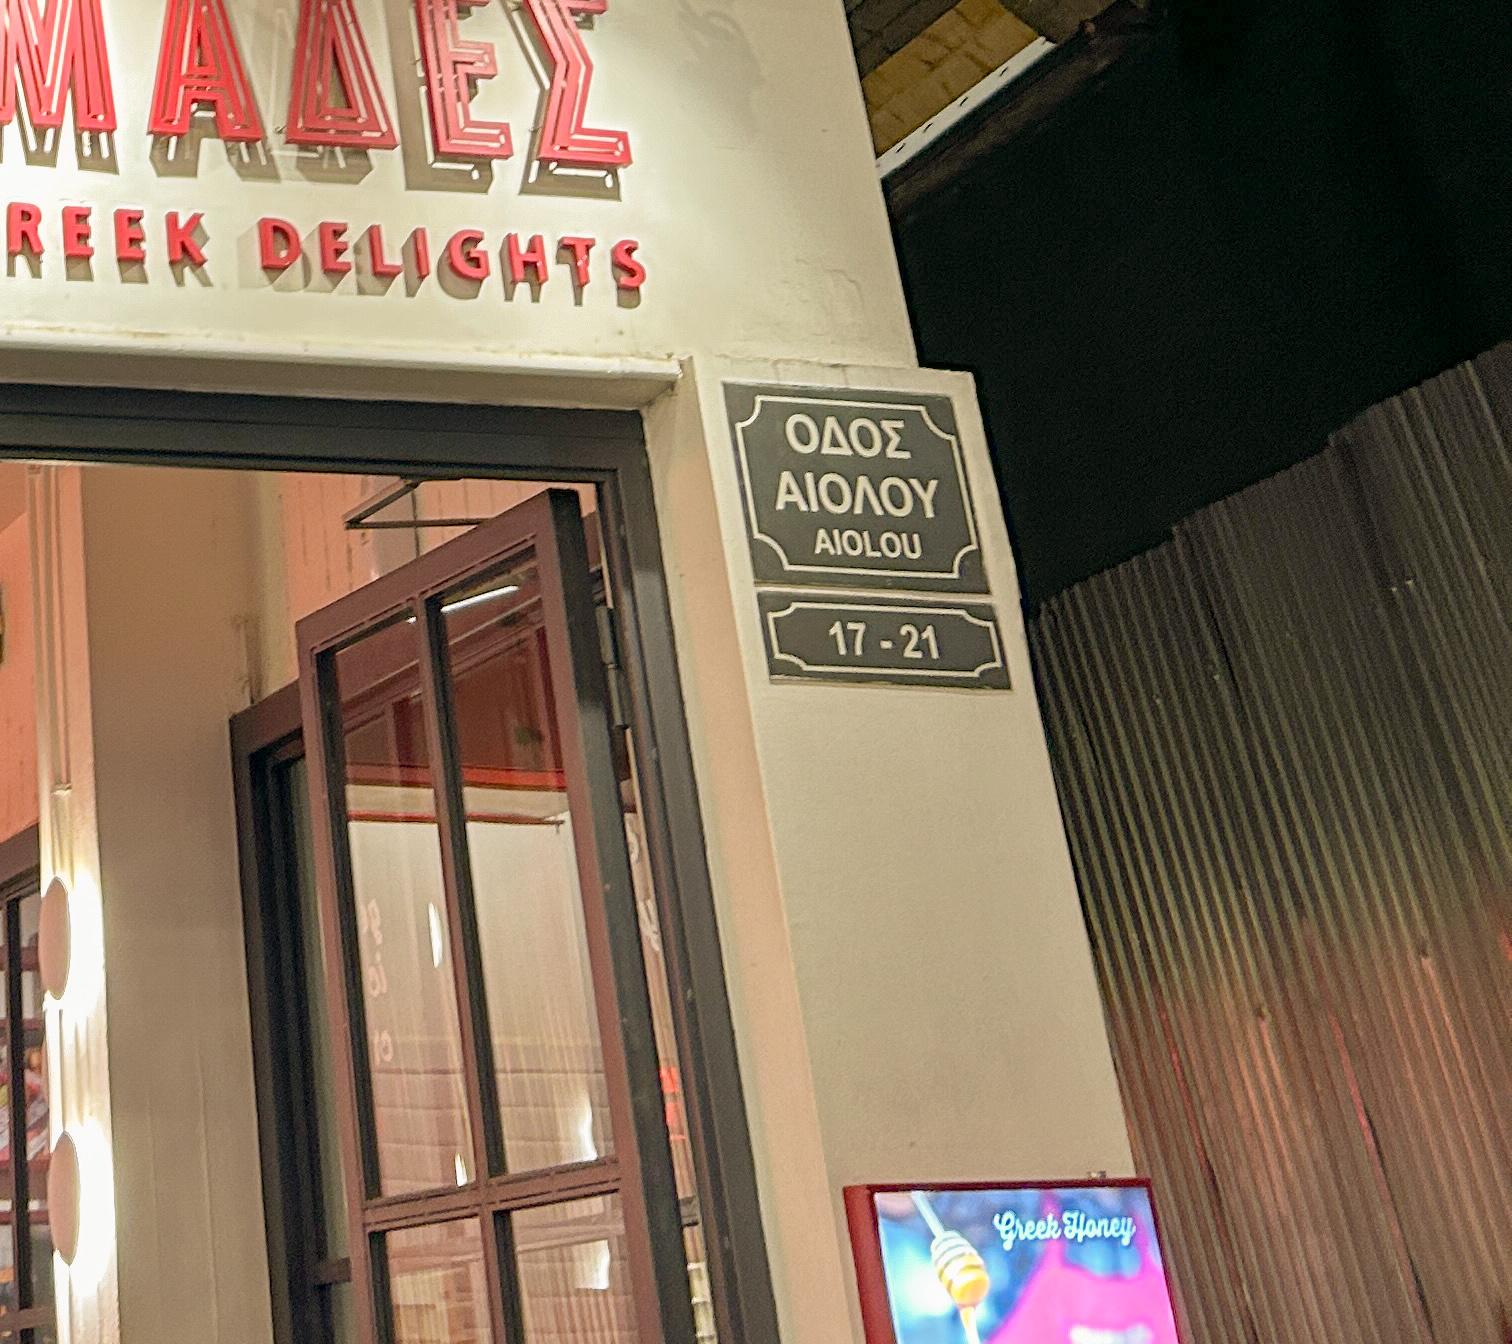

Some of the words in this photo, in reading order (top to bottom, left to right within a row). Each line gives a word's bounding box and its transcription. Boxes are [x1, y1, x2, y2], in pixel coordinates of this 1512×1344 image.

[256, 216, 648, 292] DELIGHTS
[785, 413, 912, 459] ΟΔΟΣ
[774, 470, 939, 519] ΑΙΟΛΟΥ
[813, 528, 922, 559] AIOLOU
[993, 1208, 1062, 1251] Greek
[1061, 1208, 1137, 1246] Honey
